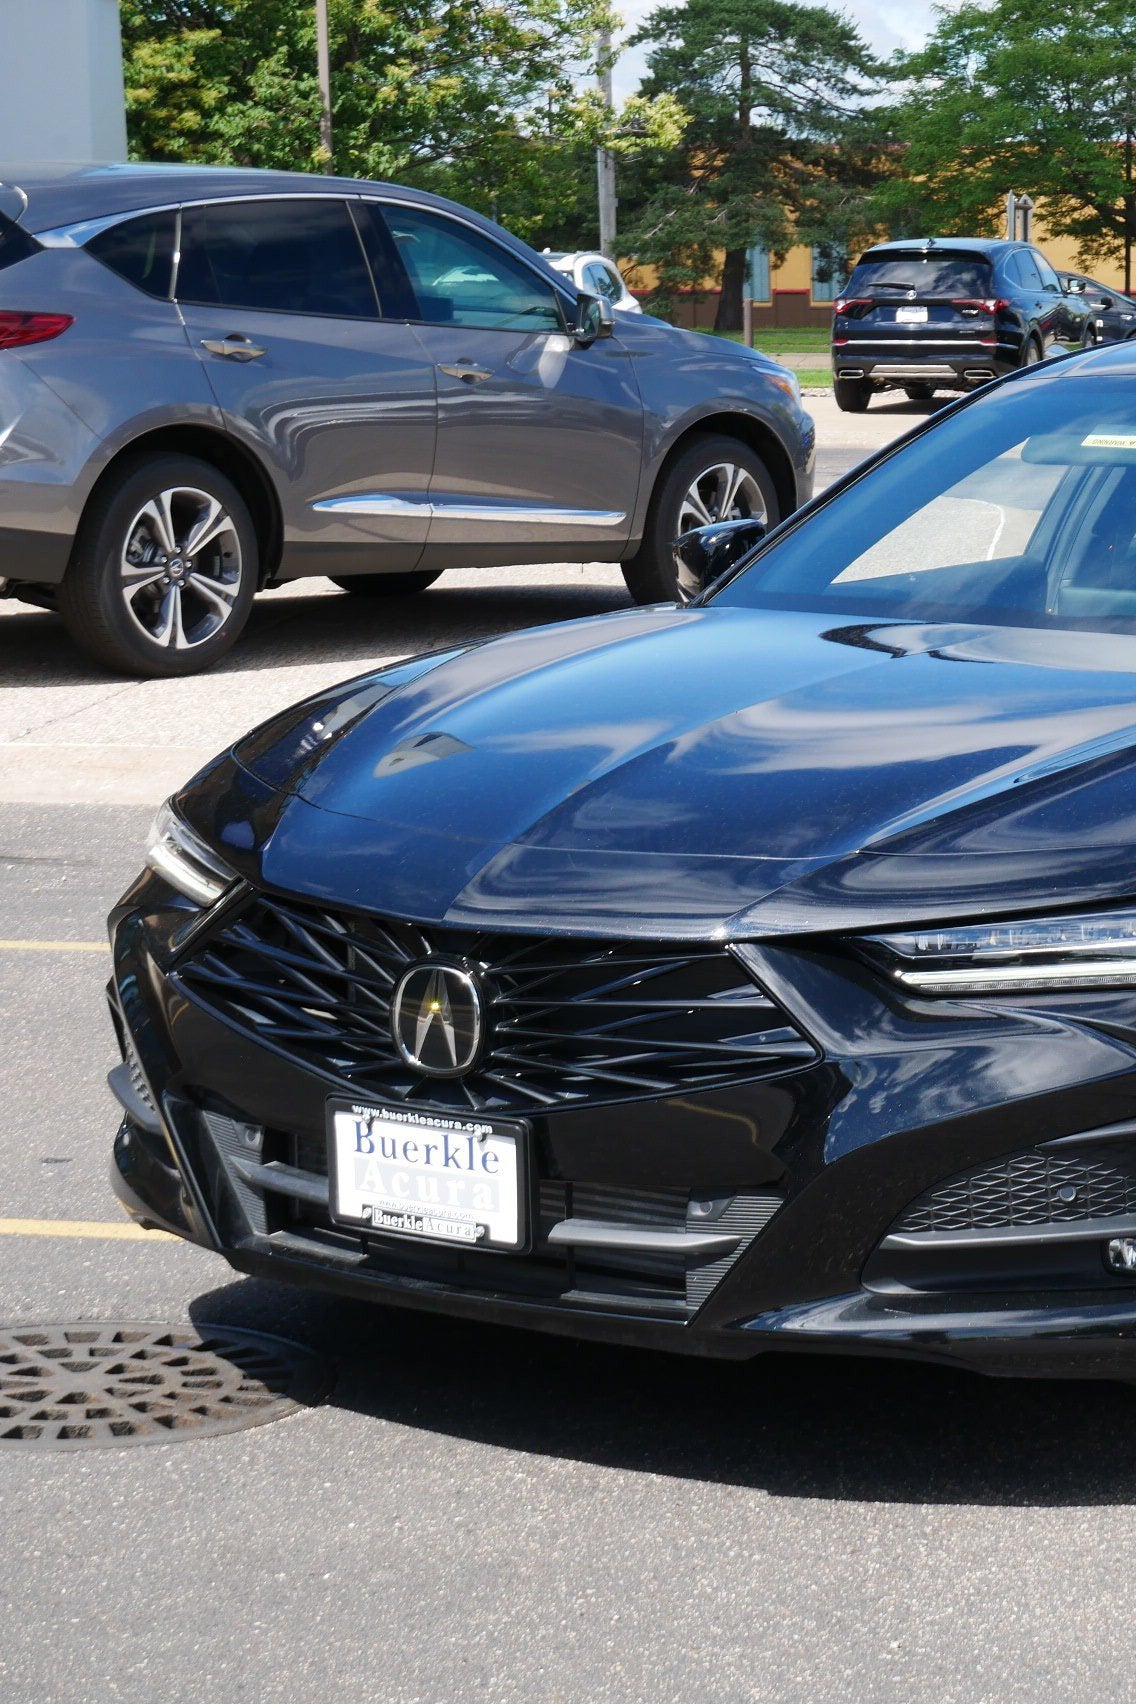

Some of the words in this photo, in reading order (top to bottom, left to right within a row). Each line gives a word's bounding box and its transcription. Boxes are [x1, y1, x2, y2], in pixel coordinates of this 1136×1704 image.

[352, 1104, 493, 1134] www.buerkleacura.com
[354, 1120, 499, 1174] Buerkle
[359, 1161, 495, 1211] Acura
